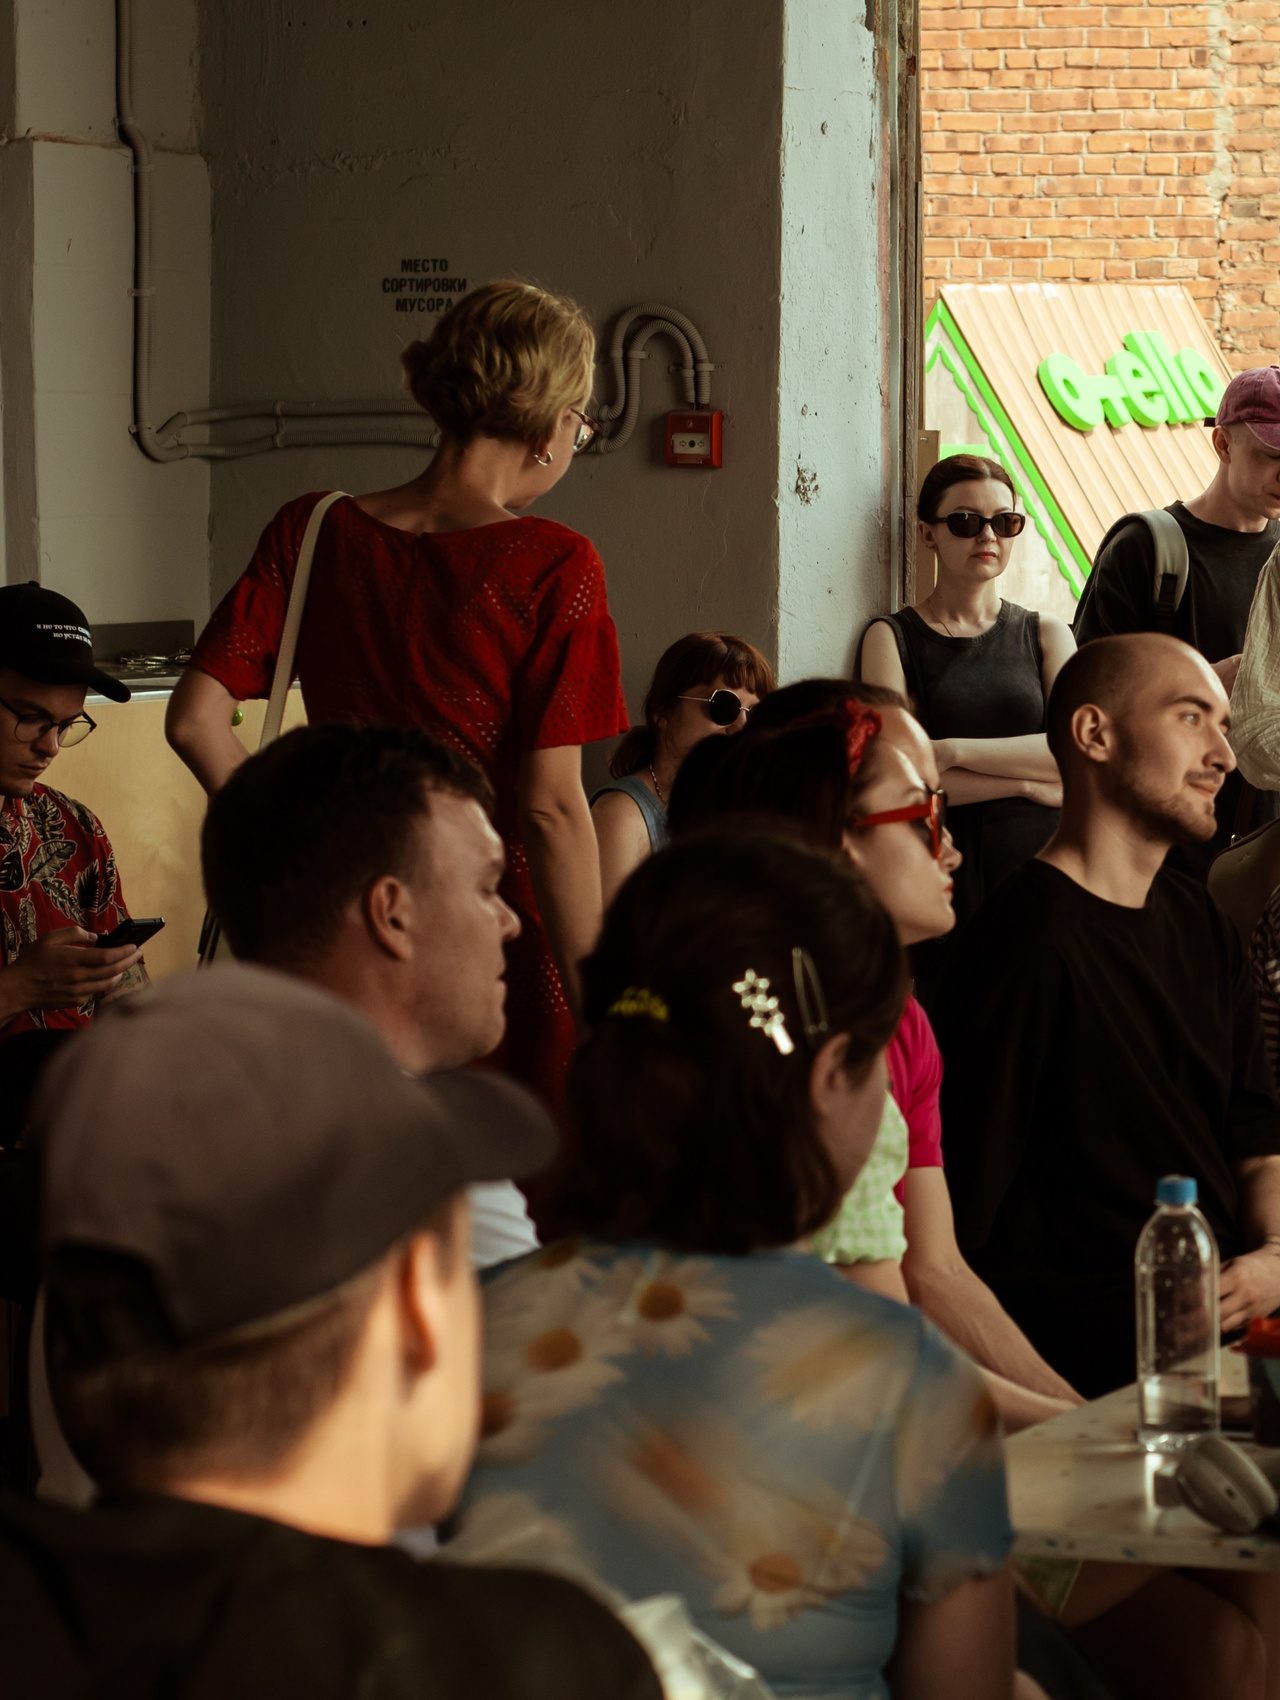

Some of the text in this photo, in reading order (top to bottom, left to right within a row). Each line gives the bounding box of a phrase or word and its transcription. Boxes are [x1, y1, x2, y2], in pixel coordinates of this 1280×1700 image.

[401, 259, 448, 273] МЕСТО
[382, 278, 467, 293] СОРТИРОВКИ
[395, 298, 453, 312] МУСОРА
